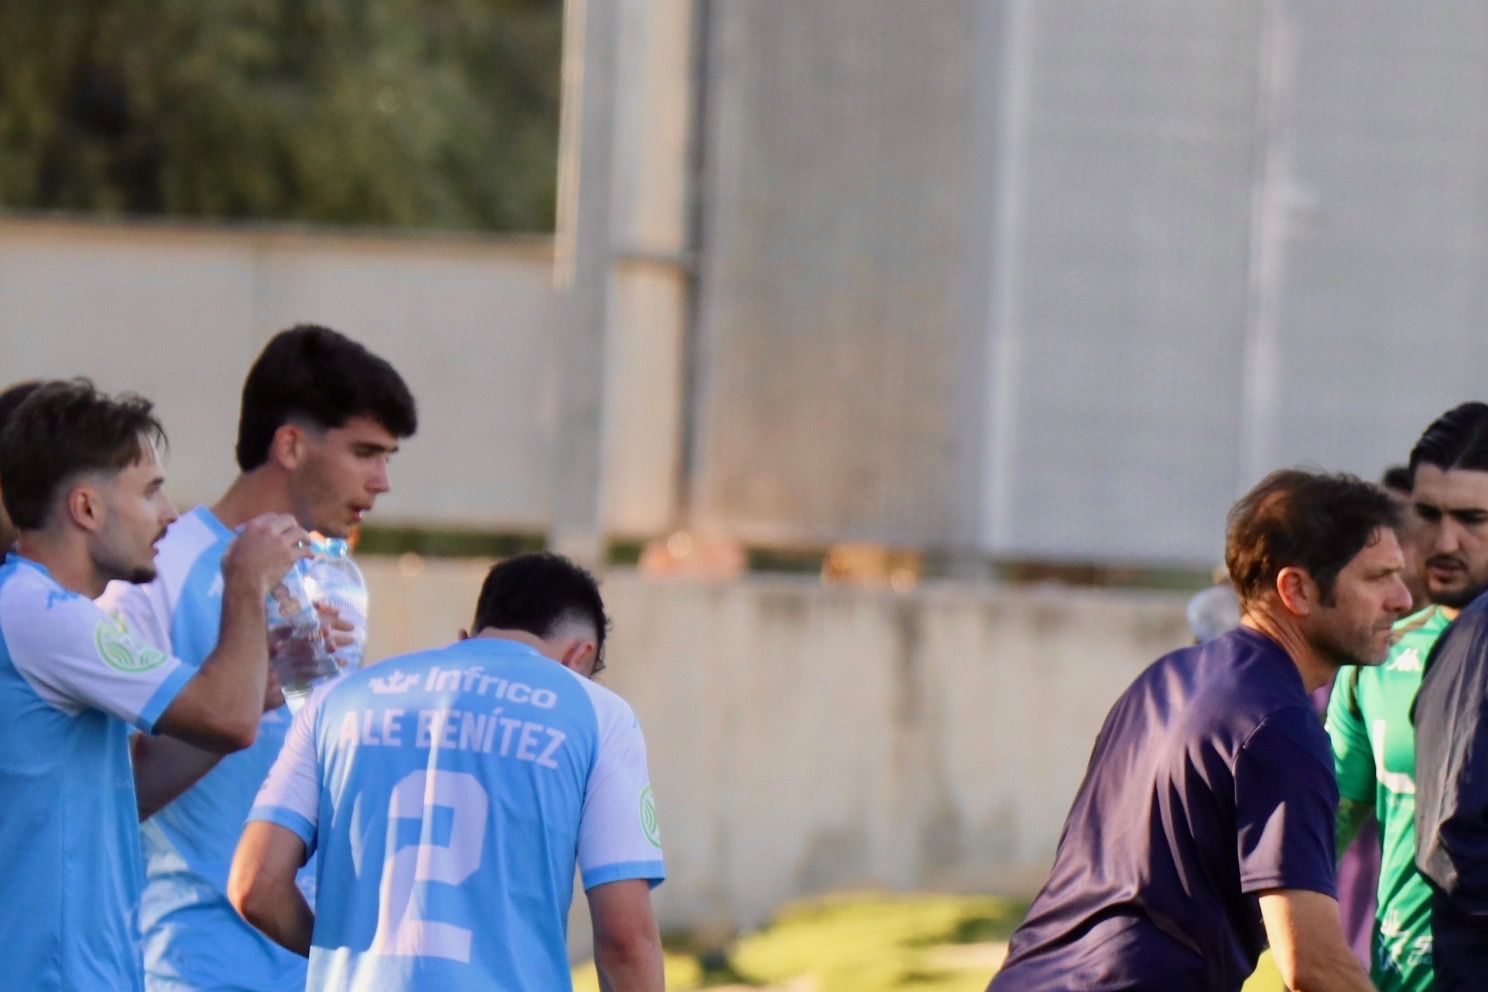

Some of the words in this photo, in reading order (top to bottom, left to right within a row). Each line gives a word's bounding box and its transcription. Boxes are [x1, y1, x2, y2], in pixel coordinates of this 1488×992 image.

[339, 708, 405, 749] ALE
[415, 706, 566, 769] BENÍTEZ
[375, 769, 489, 964] 2
